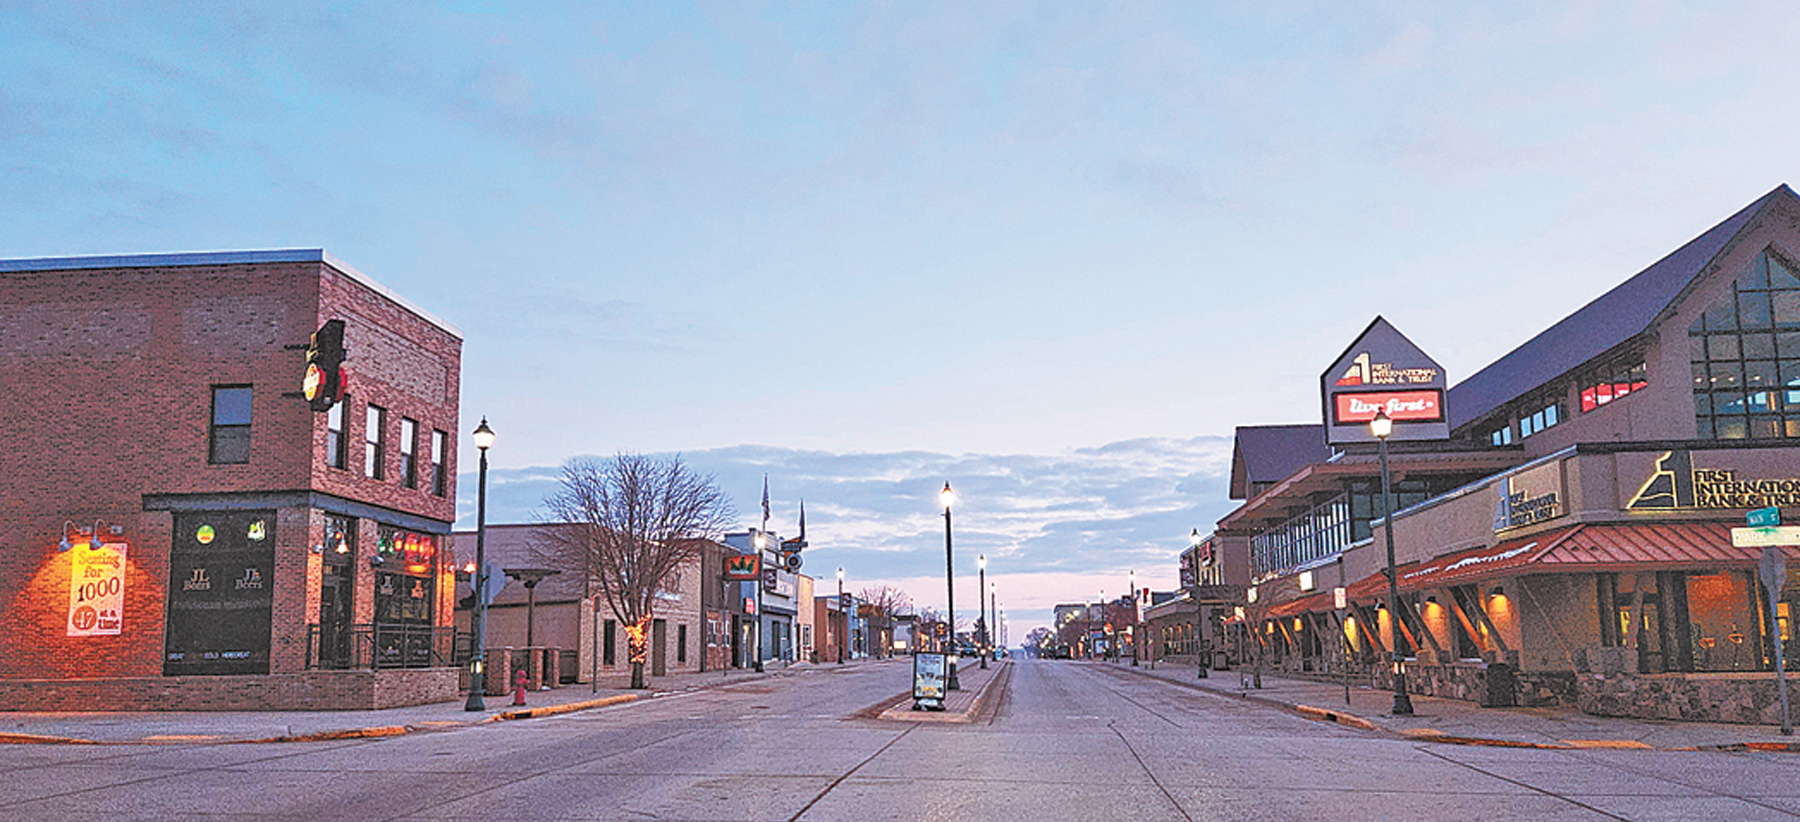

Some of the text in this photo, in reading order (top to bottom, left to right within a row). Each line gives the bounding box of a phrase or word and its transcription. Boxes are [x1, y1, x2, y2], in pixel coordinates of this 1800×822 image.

[1372, 368, 1438, 378] INTERNATIONAL
[1372, 376, 1397, 385] BANK
[1694, 469, 1736, 482] FIRST
[1697, 494, 1743, 507] BANK
[1746, 494, 1761, 506] &
[84, 565, 104, 578] for
[191, 568, 210, 582] JL
[78, 576, 120, 602] 1000
[183, 579, 211, 591] Beers
[234, 578, 263, 591] Beers
[76, 611, 95, 629] 47
[98, 618, 120, 630] time
